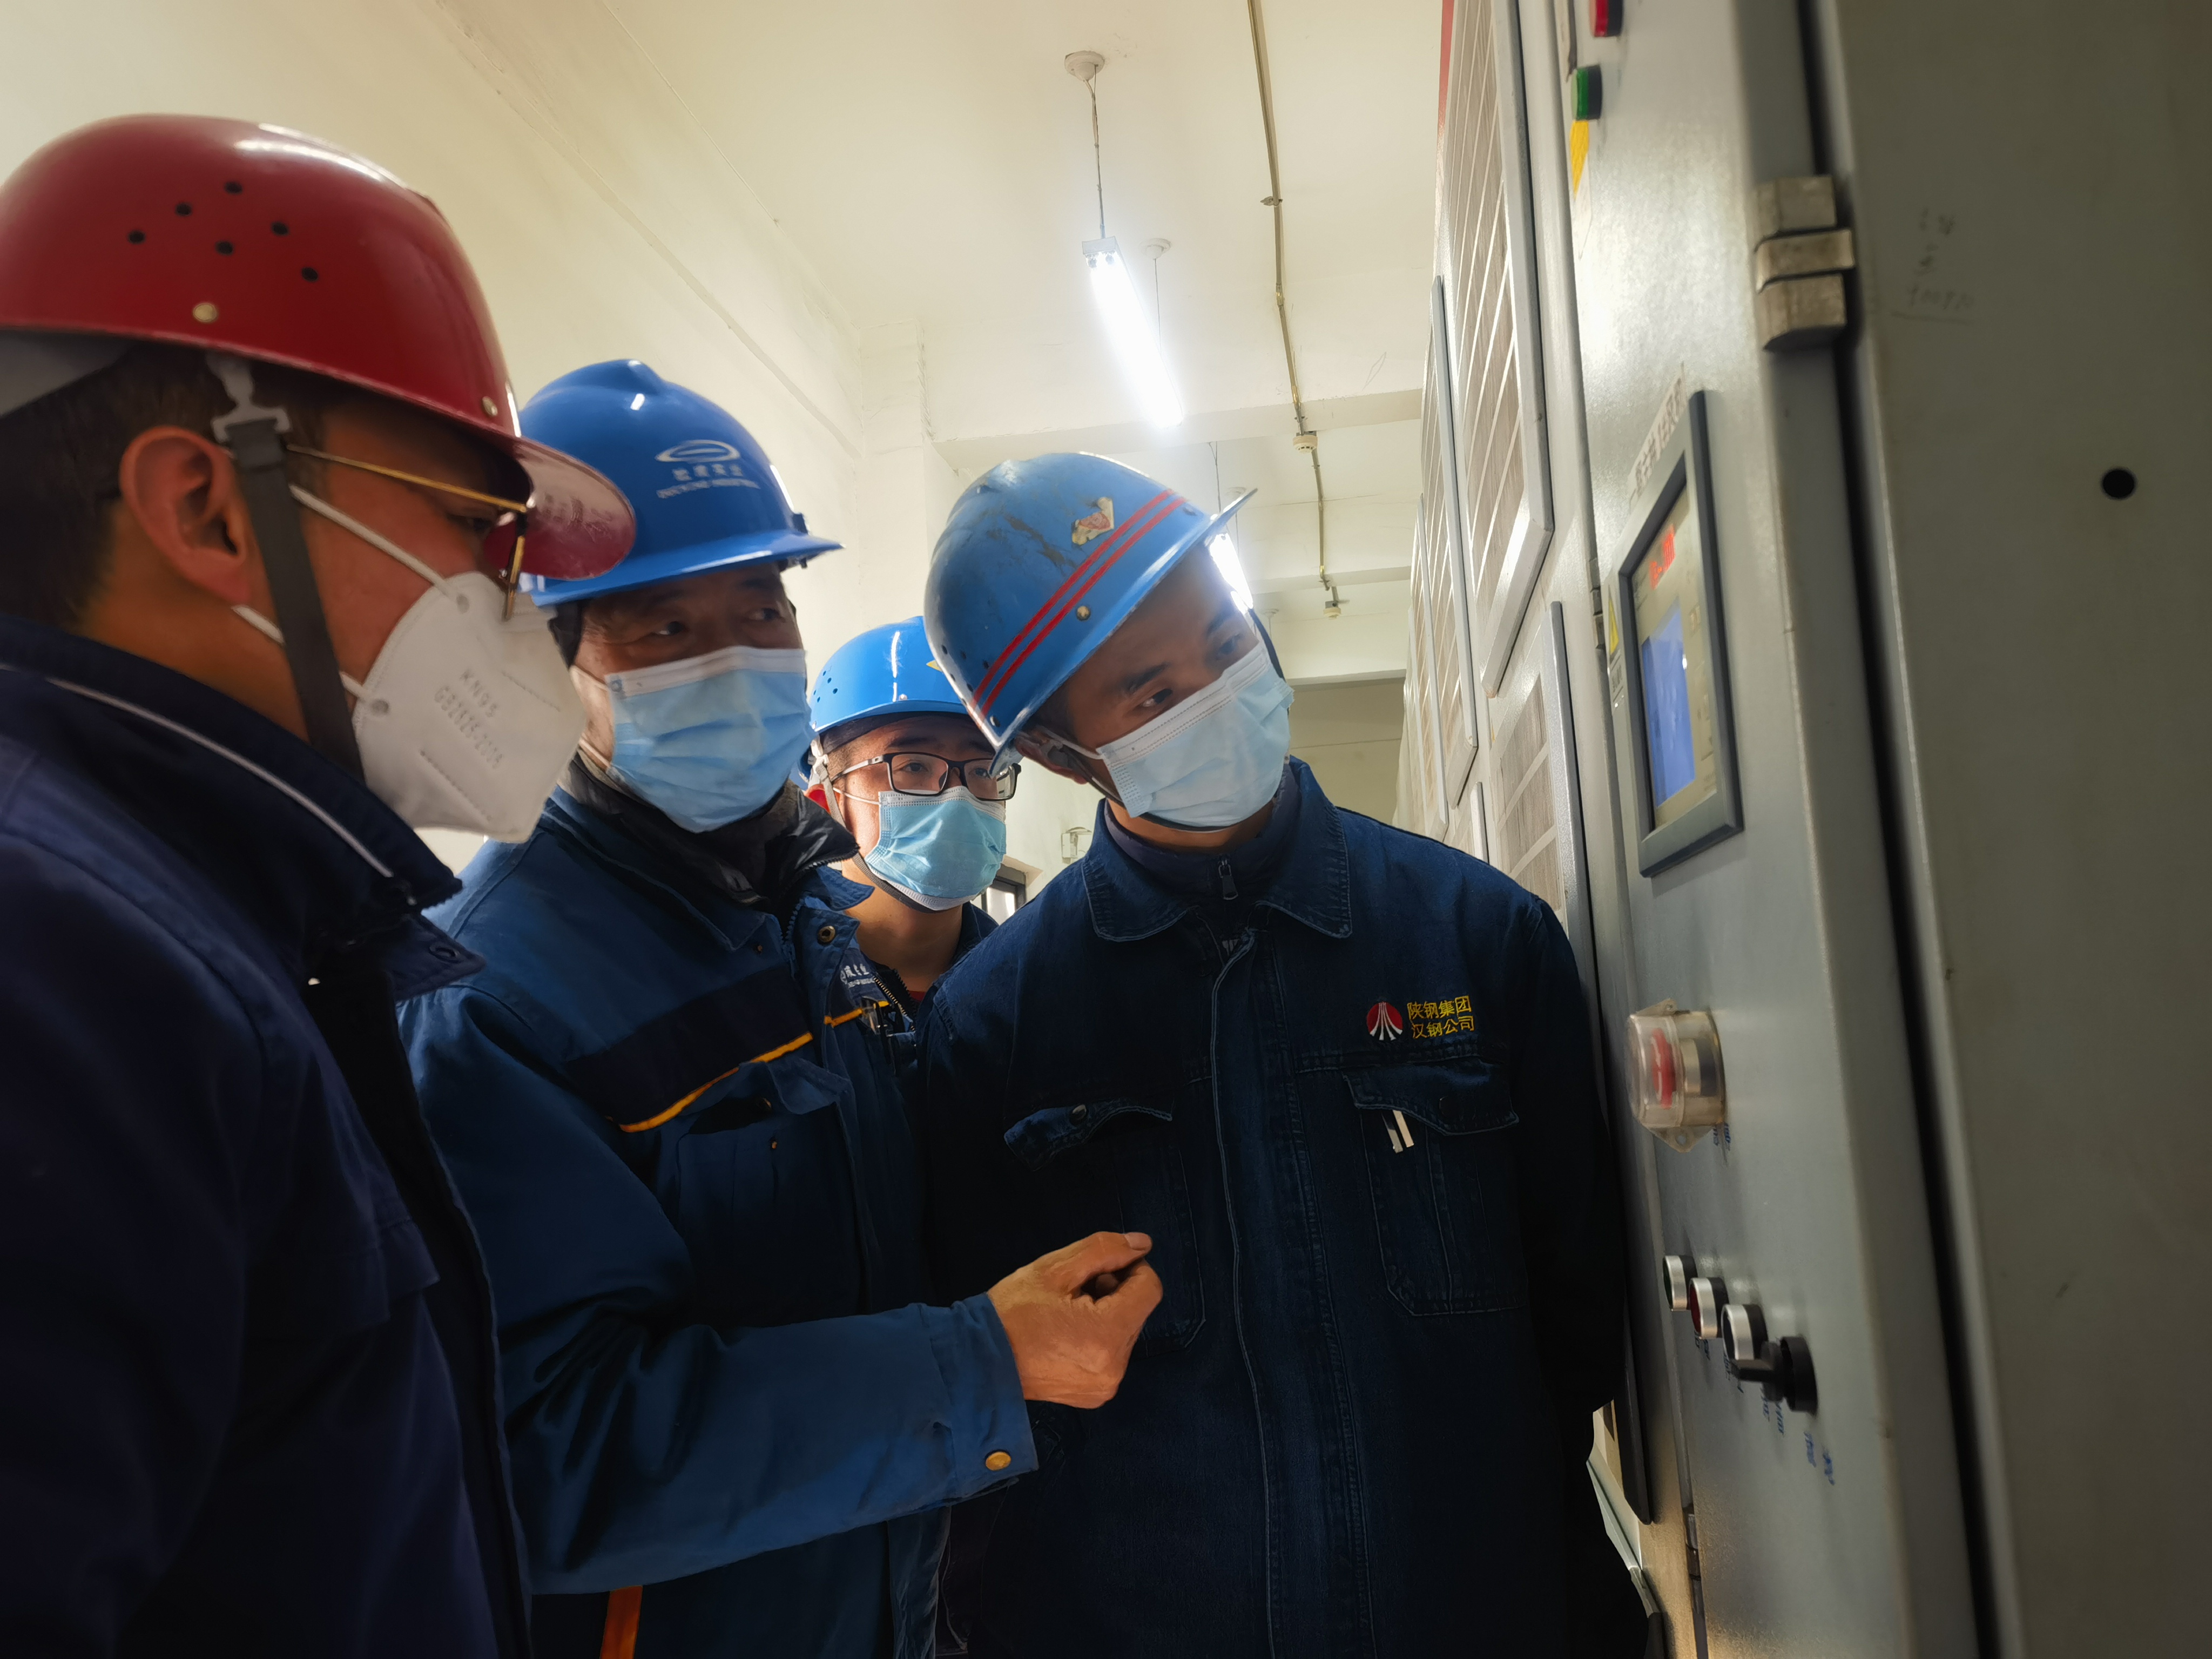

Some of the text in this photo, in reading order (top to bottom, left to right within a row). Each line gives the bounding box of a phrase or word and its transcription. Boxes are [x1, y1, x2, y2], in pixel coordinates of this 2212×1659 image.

[460, 669, 498, 718] KN95
[1407, 995, 1472, 1020] 陕钢集团
[1411, 1015, 1475, 1039] 汉钢公司
